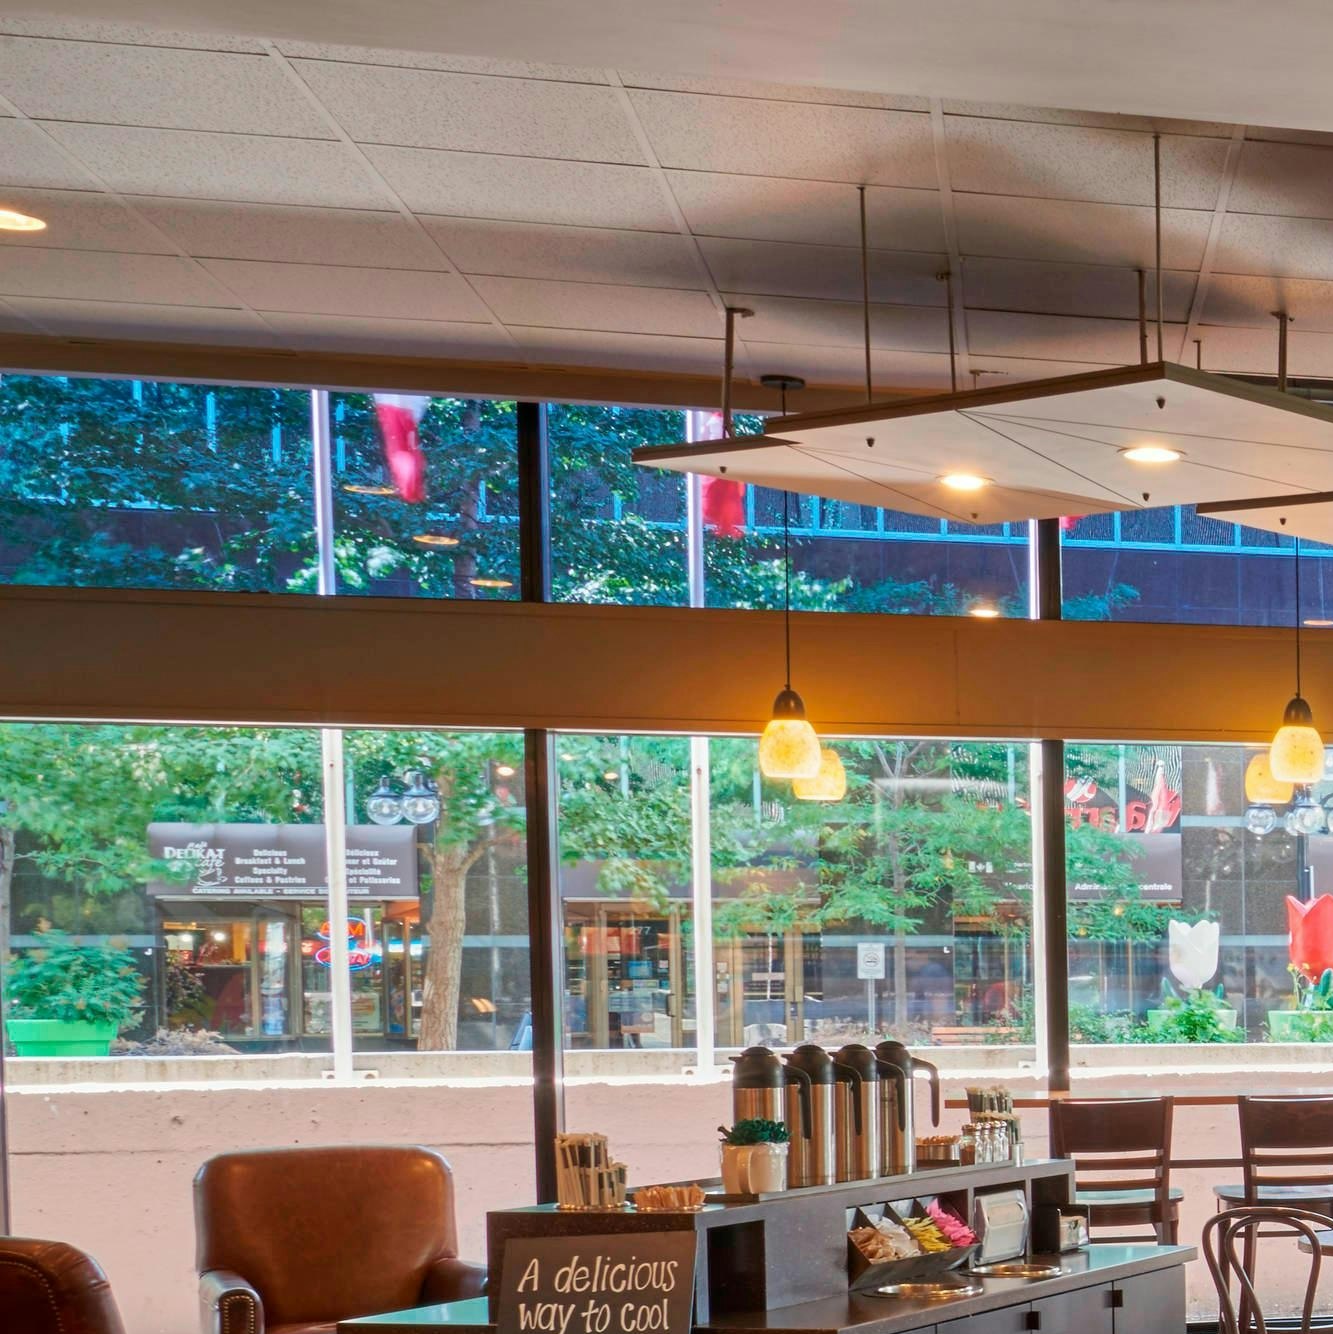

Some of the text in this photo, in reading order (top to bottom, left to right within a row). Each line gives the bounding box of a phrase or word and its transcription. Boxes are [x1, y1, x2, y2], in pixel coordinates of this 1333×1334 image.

[517, 1255, 679, 1294] A delicious
[581, 1300, 611, 1333] to
[620, 1298, 669, 1332] cool
